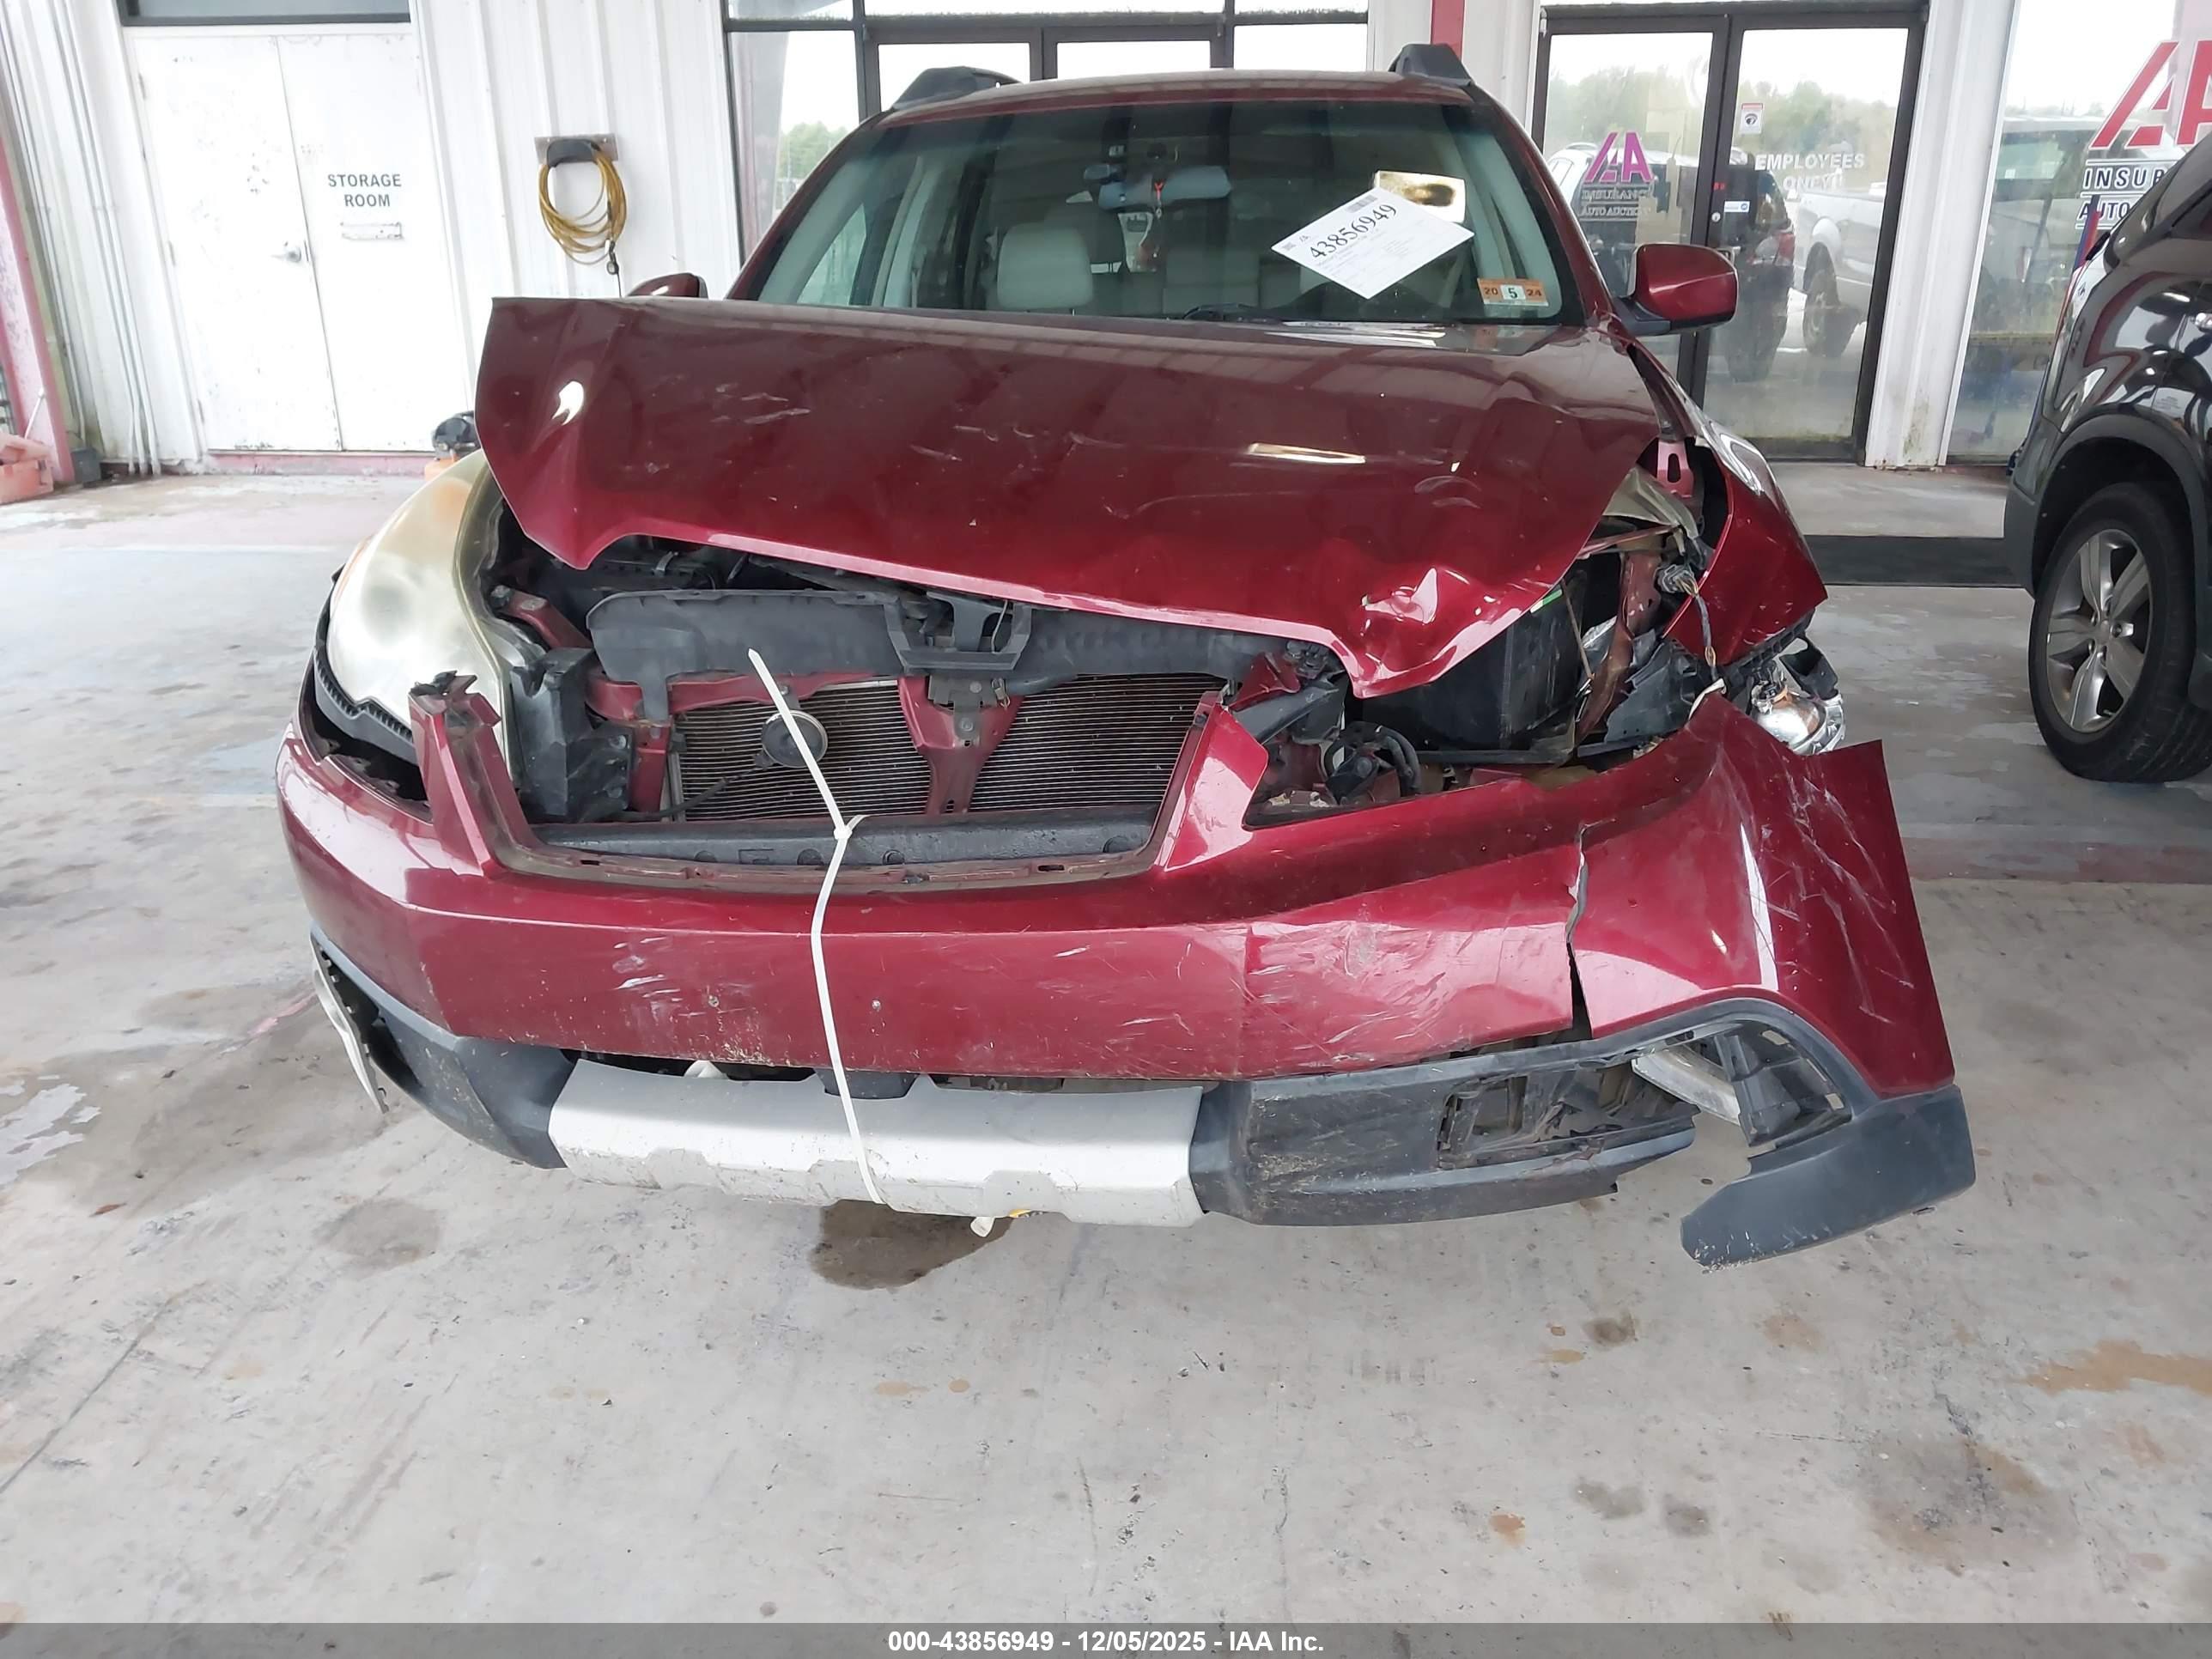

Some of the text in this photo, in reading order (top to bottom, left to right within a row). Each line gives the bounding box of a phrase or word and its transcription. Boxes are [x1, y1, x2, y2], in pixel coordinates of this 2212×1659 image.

[1754, 153, 1865, 171] EMPLOYEES
[327, 173, 402, 187] STORAGE
[343, 193, 391, 207] ROOM
[1309, 204, 1397, 259] 43856949
[1484, 287, 1498, 295] 20
[1508, 287, 1518, 299] 5
